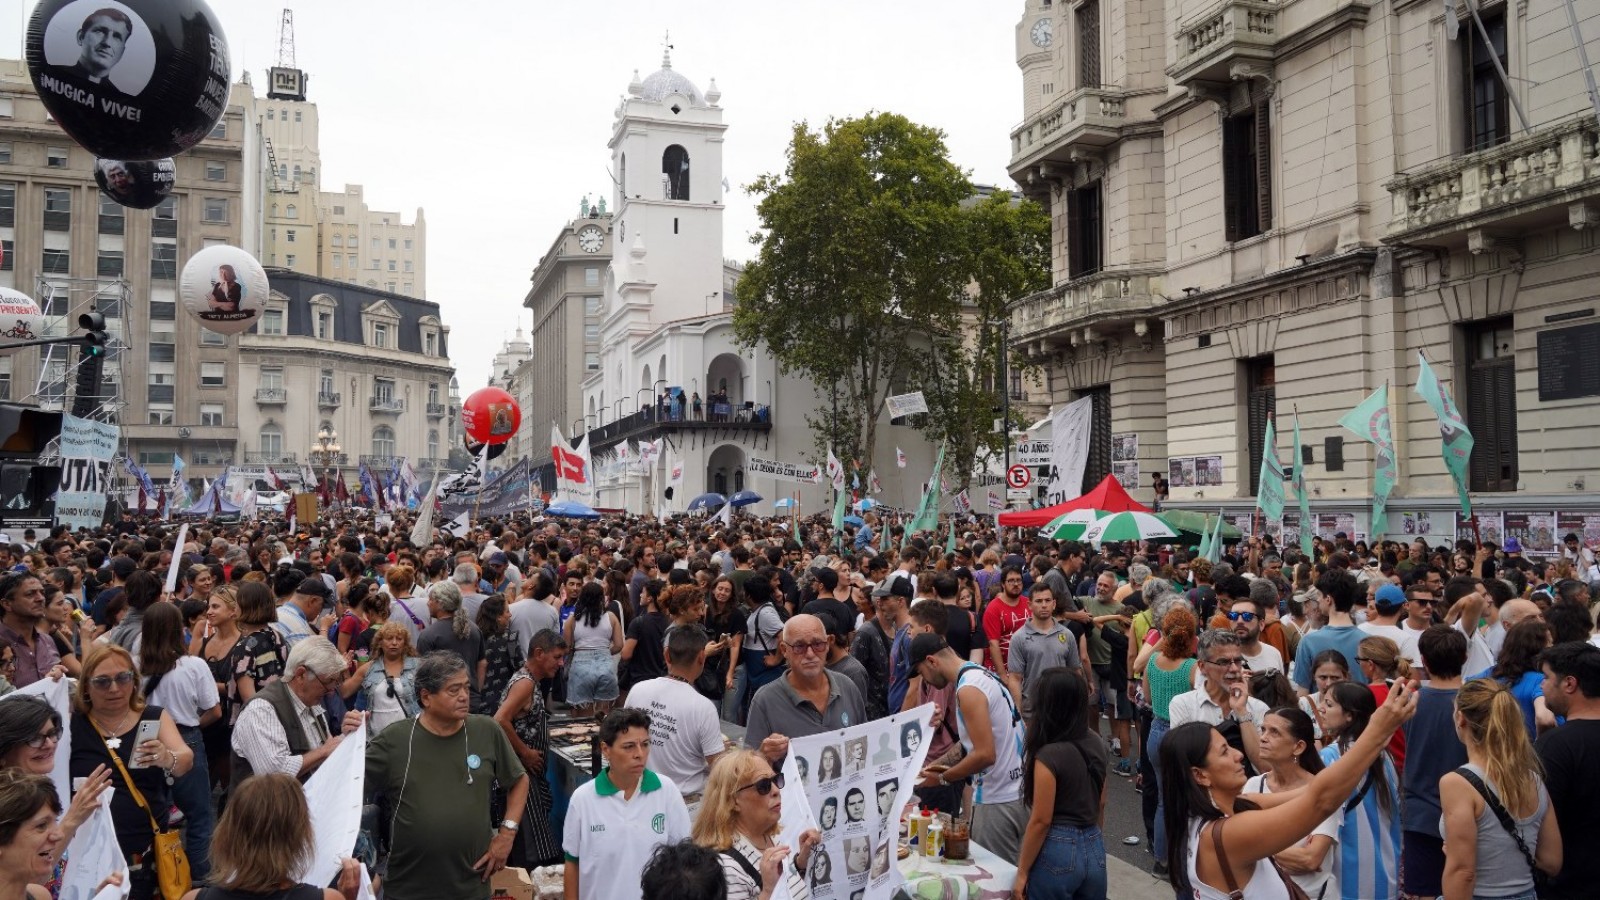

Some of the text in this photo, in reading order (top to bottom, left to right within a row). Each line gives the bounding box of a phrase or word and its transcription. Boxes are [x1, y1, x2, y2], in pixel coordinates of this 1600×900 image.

[41, 72, 141, 122] ¡MUGICA VIVE!
[1019, 441, 1049, 454] 40 AÑOS
[776, 467, 783, 475] ES
[784, 468, 795, 476] CON
[796, 470, 813, 479] ELLAS
[1014, 469, 1024, 484] E
